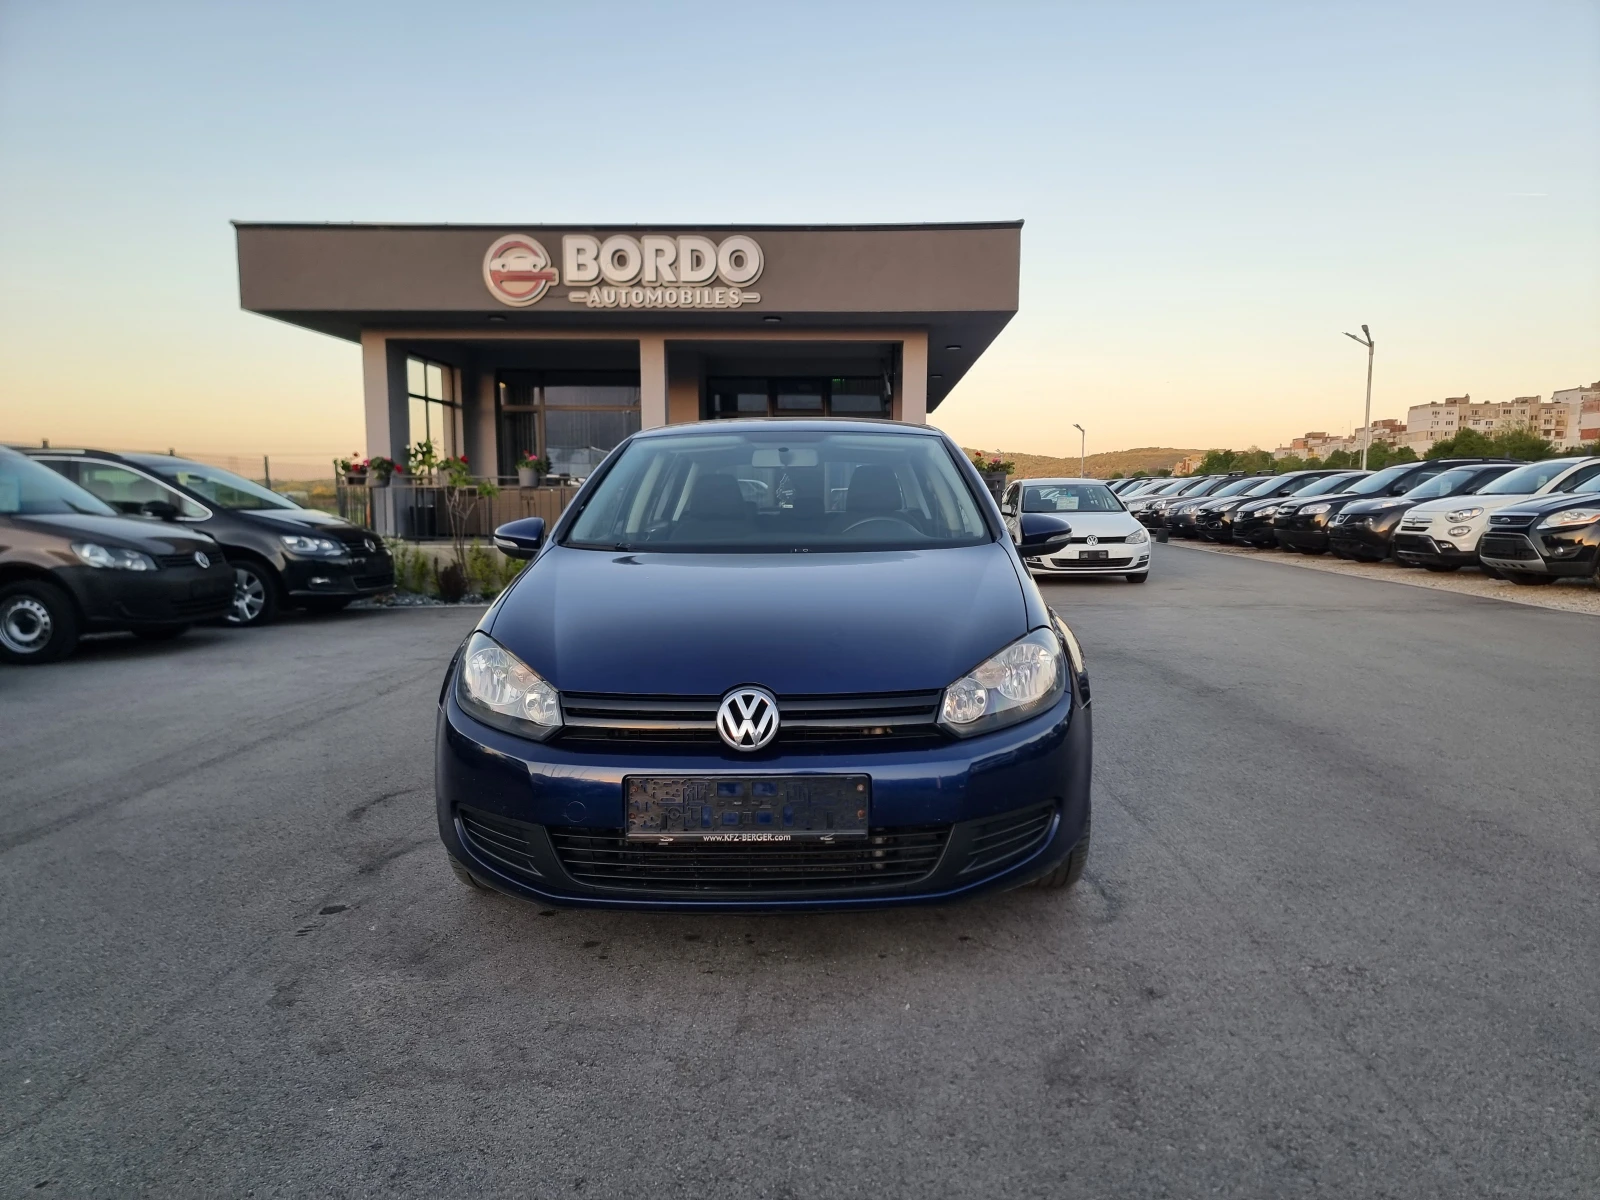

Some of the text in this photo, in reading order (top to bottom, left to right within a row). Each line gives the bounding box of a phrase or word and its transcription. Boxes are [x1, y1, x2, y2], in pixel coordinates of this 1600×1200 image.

[563, 235, 762, 284] BORDO
[588, 289, 742, 305] AUTOMOBILES
[719, 691, 778, 749] VW
[702, 833, 792, 843] www.KFZ-BERGER.com
